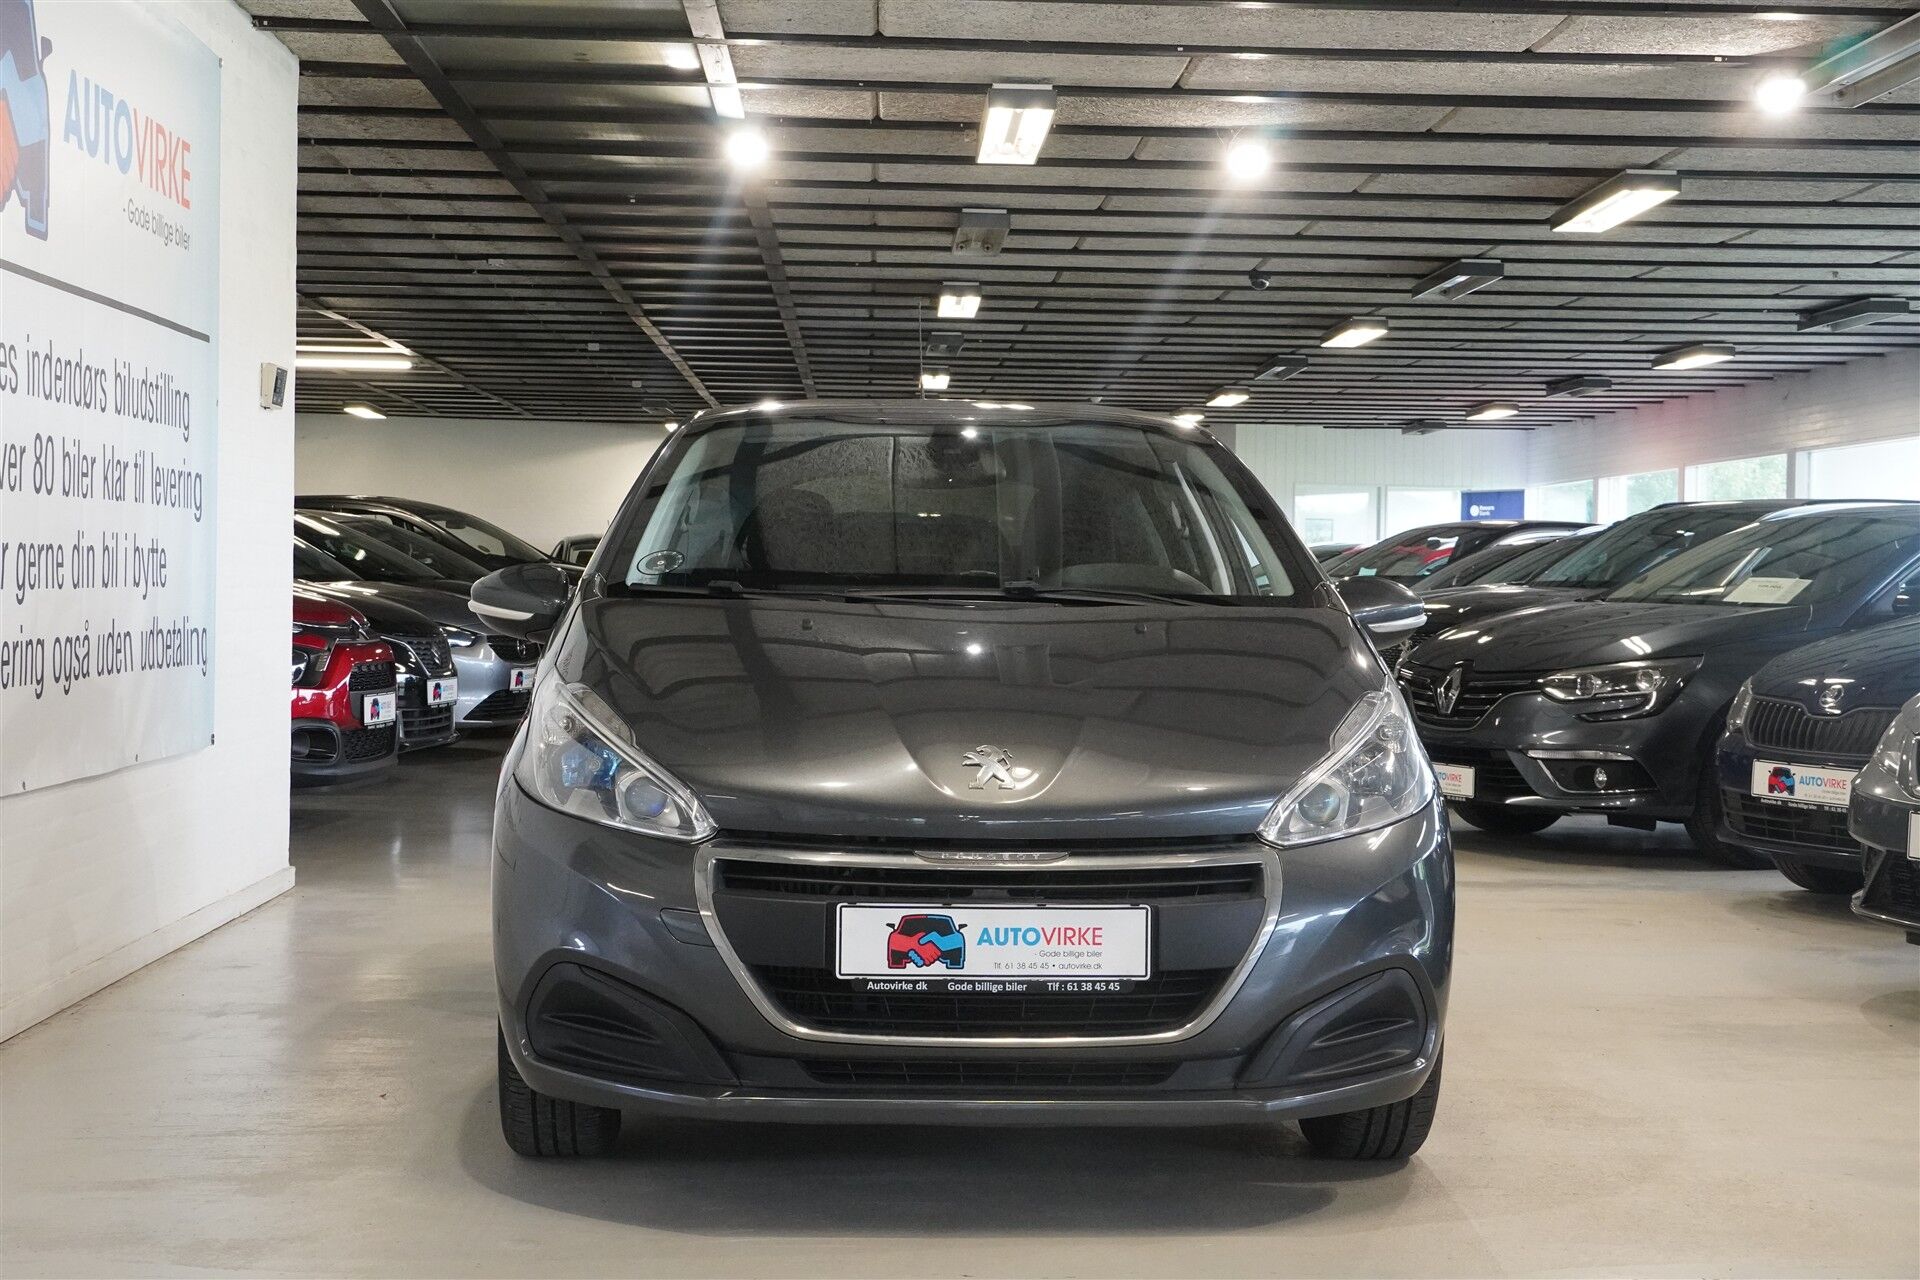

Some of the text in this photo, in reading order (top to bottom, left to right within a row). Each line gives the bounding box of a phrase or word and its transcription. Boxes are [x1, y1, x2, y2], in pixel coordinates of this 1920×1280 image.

[63, 69, 191, 210] AUTOVIRKE
[127, 198, 151, 232] Gode
[151, 209, 174, 247] billige
[174, 221, 190, 251] biler
[27, 334, 107, 413] indendørs
[114, 358, 190, 442] biludstilling
[33, 432, 55, 495] 80
[62, 436, 96, 499] biler
[103, 443, 129, 502] klar
[133, 450, 146, 504] til
[151, 452, 202, 522] levering
[16, 542, 64, 605] gerne
[71, 530, 95, 590] din
[102, 531, 119, 589] bil
[124, 533, 128, 588] i
[133, 533, 167, 600] bytte
[53, 620, 91, 695] også
[97, 618, 133, 677] uden
[140, 616, 207, 677] udbetaling
[1799, 775, 1847, 790] AUTOVIRKE
[977, 927, 1103, 946] AUTOVIRKE
[1039, 949, 1062, 958] Gode
[1062, 949, 1085, 960] billige
[1086, 949, 1103, 958] biler
[1004, 962, 1015, 971] 61
[1016, 962, 1027, 971] 38
[1028, 962, 1038, 971] 45
[1040, 962, 1050, 971] 45
[867, 981, 928, 991] Autovirke dk
[947, 981, 1028, 993] Gode billige biler
[1047, 981, 1060, 992] Tlf
[1066, 982, 1078, 992] 61
[1080, 982, 1092, 992] 38
[1094, 982, 1106, 992] 45
[1108, 982, 1120, 992] 45
